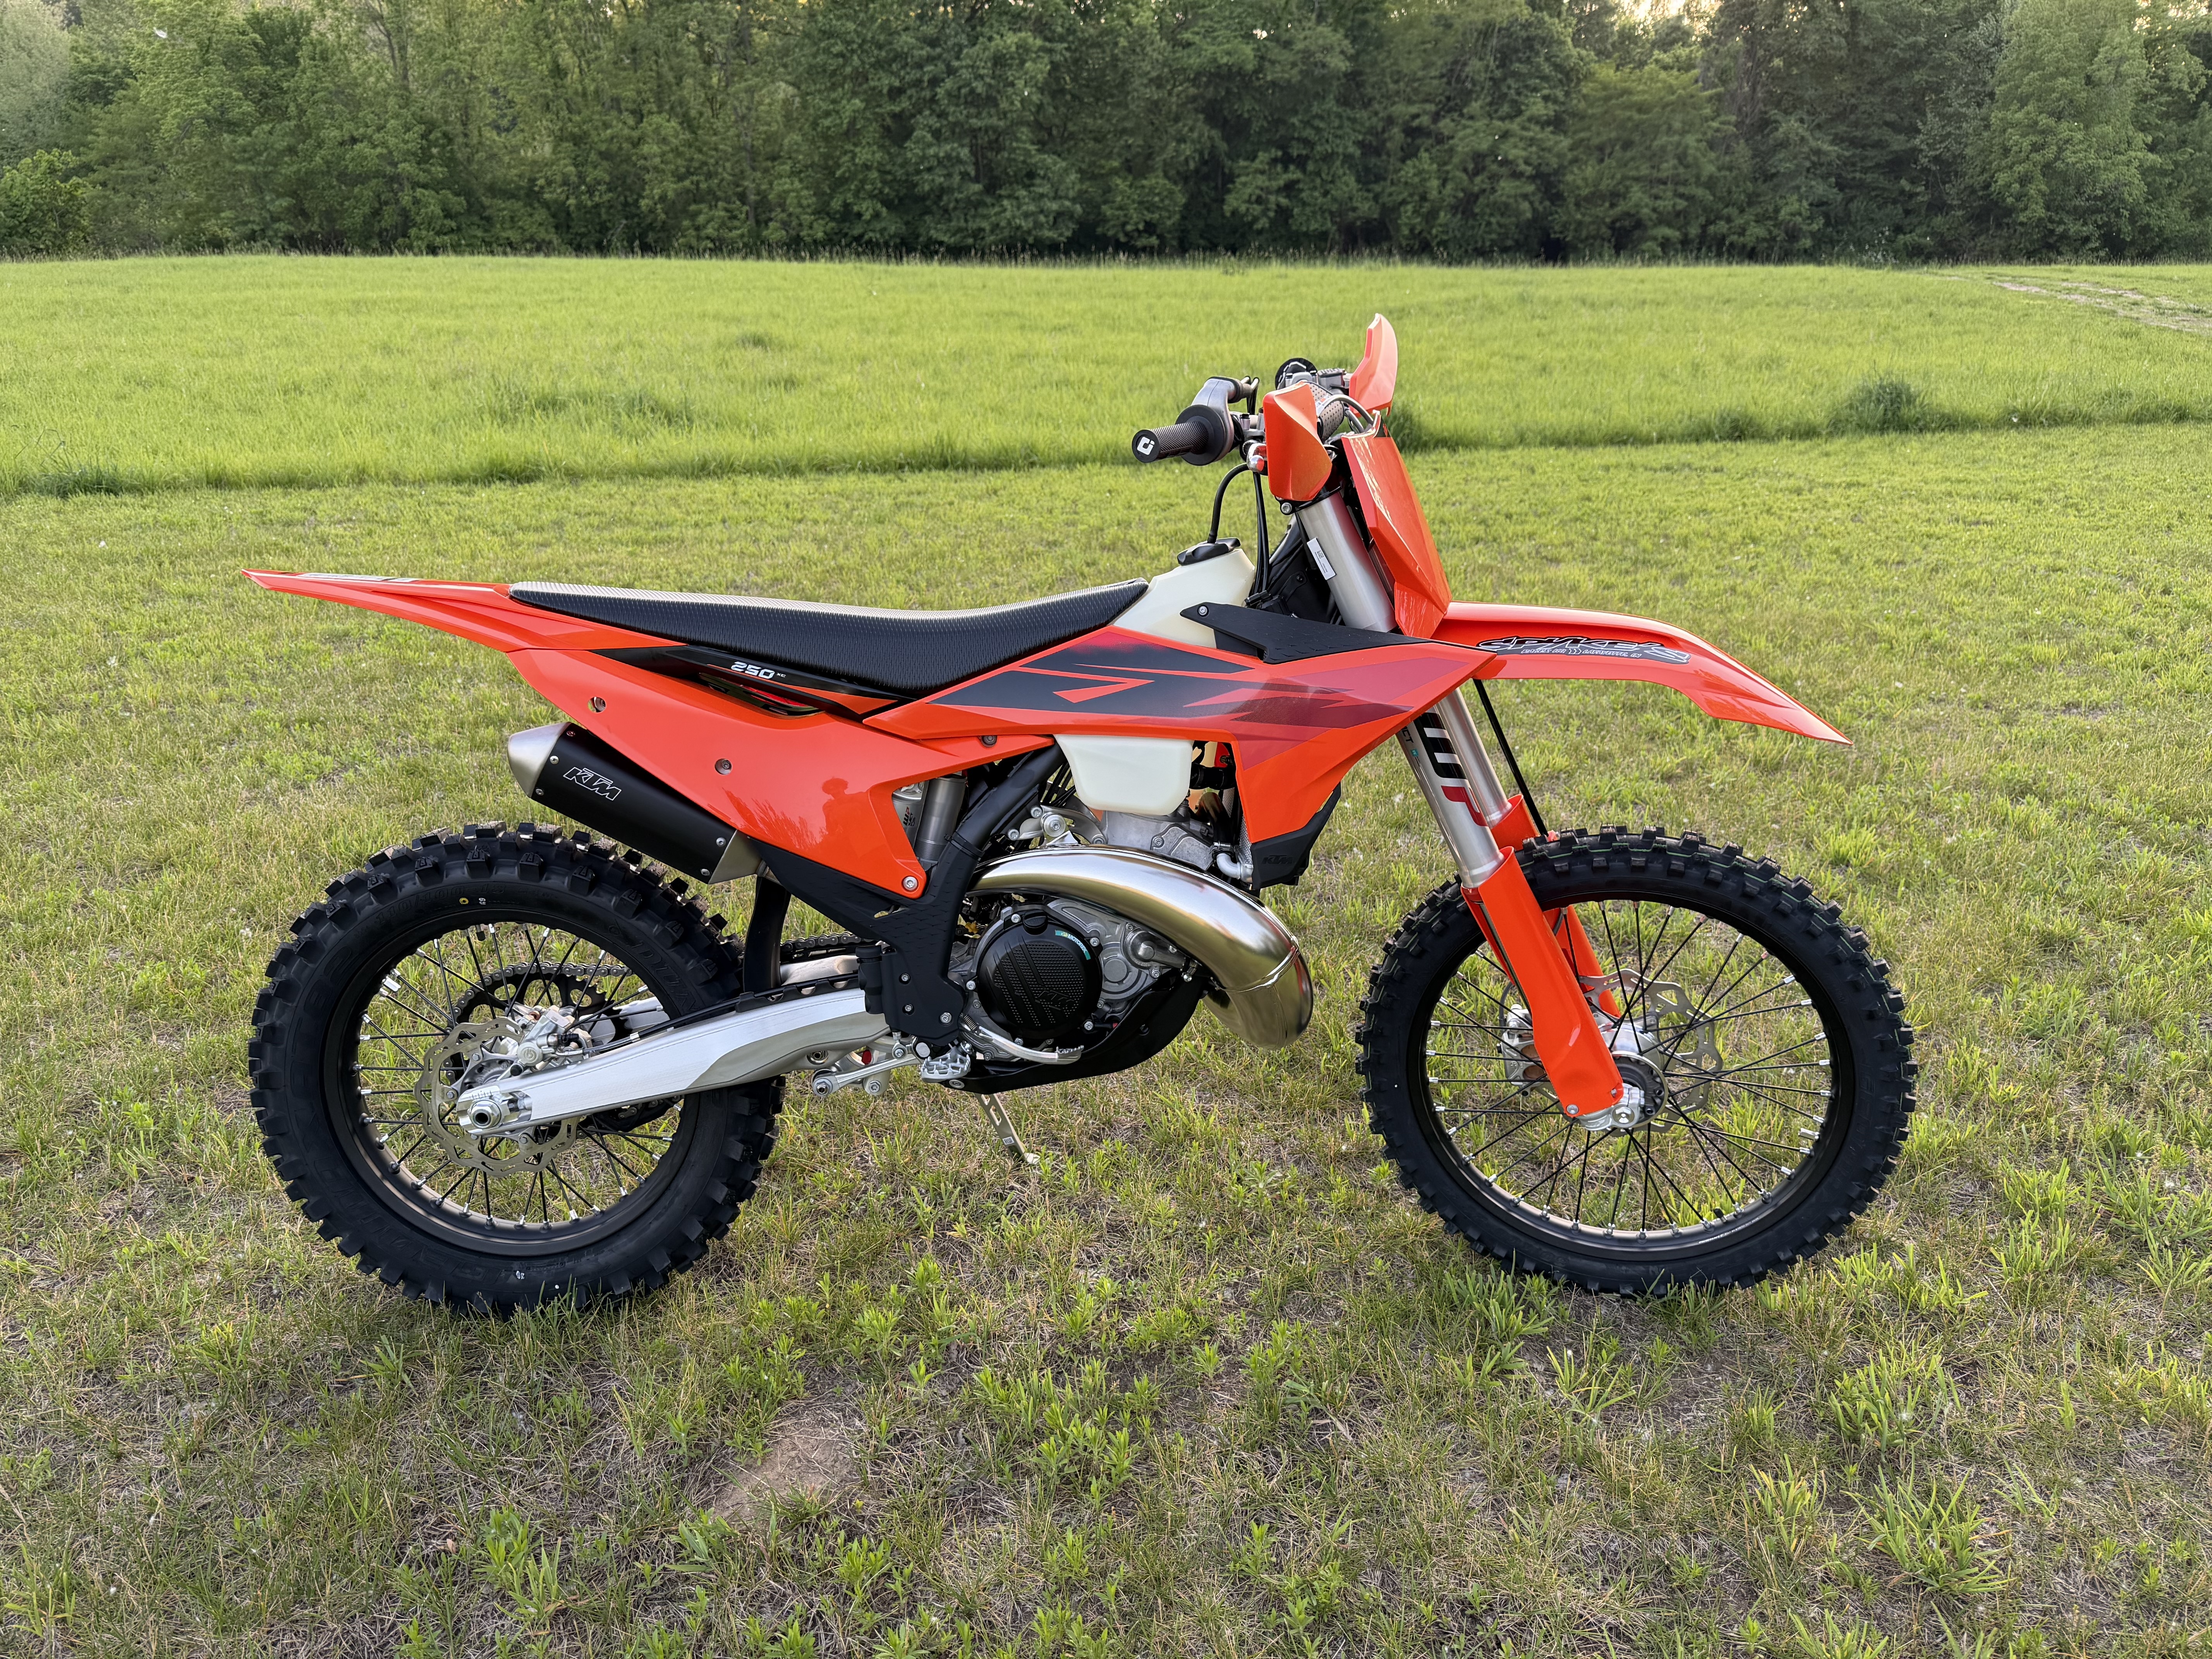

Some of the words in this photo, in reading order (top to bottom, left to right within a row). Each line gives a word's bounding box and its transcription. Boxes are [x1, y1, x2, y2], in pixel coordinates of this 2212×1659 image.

[1479, 637, 1691, 662] SPYKE'S
[731, 661, 775, 679] 250
[1413, 712, 1488, 826] WP
[563, 767, 622, 801] KTM
[1262, 855, 1294, 864] KTM
